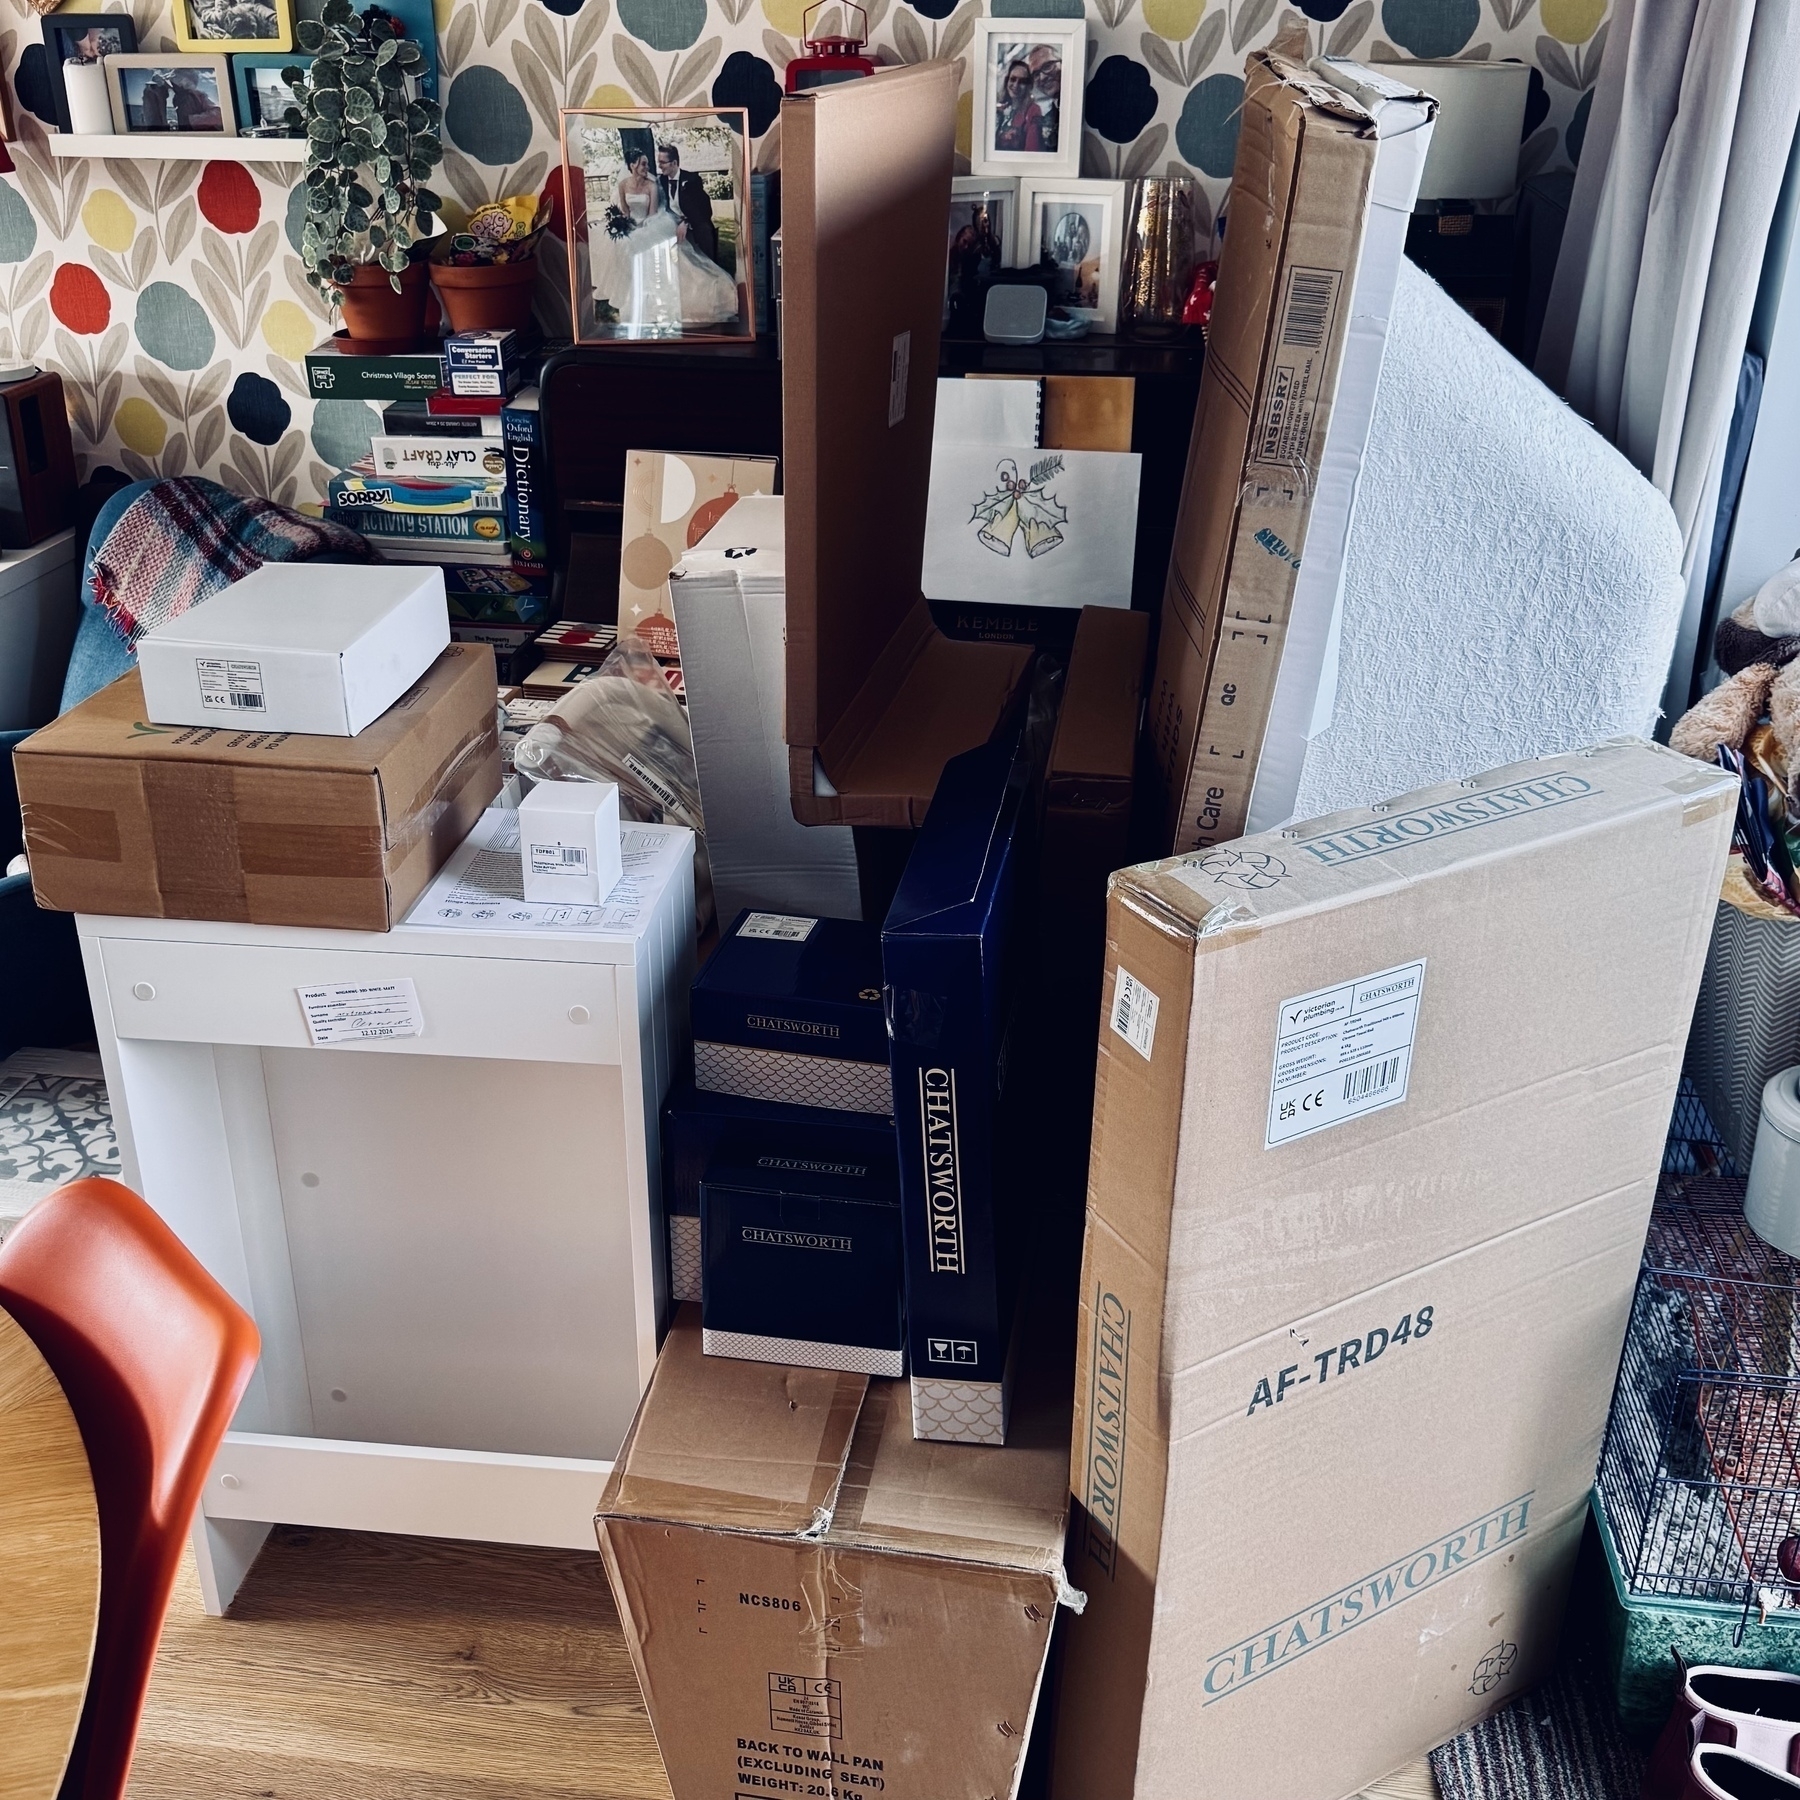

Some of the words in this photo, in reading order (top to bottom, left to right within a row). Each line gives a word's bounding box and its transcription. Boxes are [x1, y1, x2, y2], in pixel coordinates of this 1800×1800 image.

[1304, 358, 1313, 375] RAIL
[393, 372, 415, 380] Village
[1299, 375, 1310, 399] TOWEL
[1264, 372, 1288, 453] NSBSR7
[507, 424, 533, 433] Oxford
[1280, 430, 1289, 458] SQUARE
[1286, 400, 1296, 430] SHOWER
[1291, 414, 1302, 441] SCREEN
[508, 432, 534, 443] English
[402, 450, 442, 461] CRAFT
[446, 450, 476, 462] CLAY
[1287, 442, 1296, 460] BATH
[338, 488, 393, 506] SORRY!
[512, 446, 532, 542] Dictionary
[362, 513, 414, 532] ACTIVITY
[419, 516, 469, 535] STATION
[514, 560, 544, 569] OXFORD
[956, 616, 1039, 631] KEMBLE
[1221, 683, 1237, 706] QC
[227, 734, 251, 748] GROSS
[246, 735, 270, 748] GROSS
[1197, 786, 1224, 831] Care
[1300, 776, 1591, 864] CHATSWORTH
[1360, 978, 1414, 1002] CHATSWORTH
[1303, 1007, 1334, 1022] plumbing
[1304, 1000, 1336, 1014] victorian
[747, 1016, 840, 1037] CHATSWORTH
[1281, 1035, 1304, 1047] PRODUCT
[1305, 1032, 1320, 1041] CODE:
[1281, 1042, 1304, 1055] PRODUCT
[1305, 1033, 1338, 1049] DESCRIPTION:
[1278, 1068, 1295, 1077] GROSS
[1295, 1058, 1327, 1072] DIMENSIONS:
[1279, 1060, 1296, 1070] GROSS
[1296, 1054, 1316, 1066] WEIGHT:
[1285, 1071, 1307, 1082] NUMBER:
[1280, 1100, 1296, 1112] UK
[1303, 1090, 1324, 1111] CE
[1280, 1108, 1295, 1121] CA
[758, 1158, 867, 1175] CHATSWORTH
[924, 1068, 959, 1274] CHATSWORTH
[742, 1228, 852, 1250] CHATSWORTH
[1246, 1306, 1434, 1416] AF-TRD48
[1088, 1292, 1126, 1576] CHATSWORTH
[740, 1592, 801, 1612] NCS806
[1204, 1498, 1534, 1695] CHATSWORTH
[778, 1676, 795, 1685] UK
[778, 1684, 796, 1693] CA
[814, 1682, 832, 1693] CE
[737, 1738, 779, 1754] BACK
[782, 1745, 803, 1758] TO
[806, 1749, 849, 1766] WALL
[853, 1756, 883, 1771] PAN
[737, 1755, 832, 1779] (EXCLUDING
[841, 1772, 885, 1791] SEAT)
[738, 1772, 803, 1792] WEIGHT:
[807, 1785, 838, 1797] 20.6
